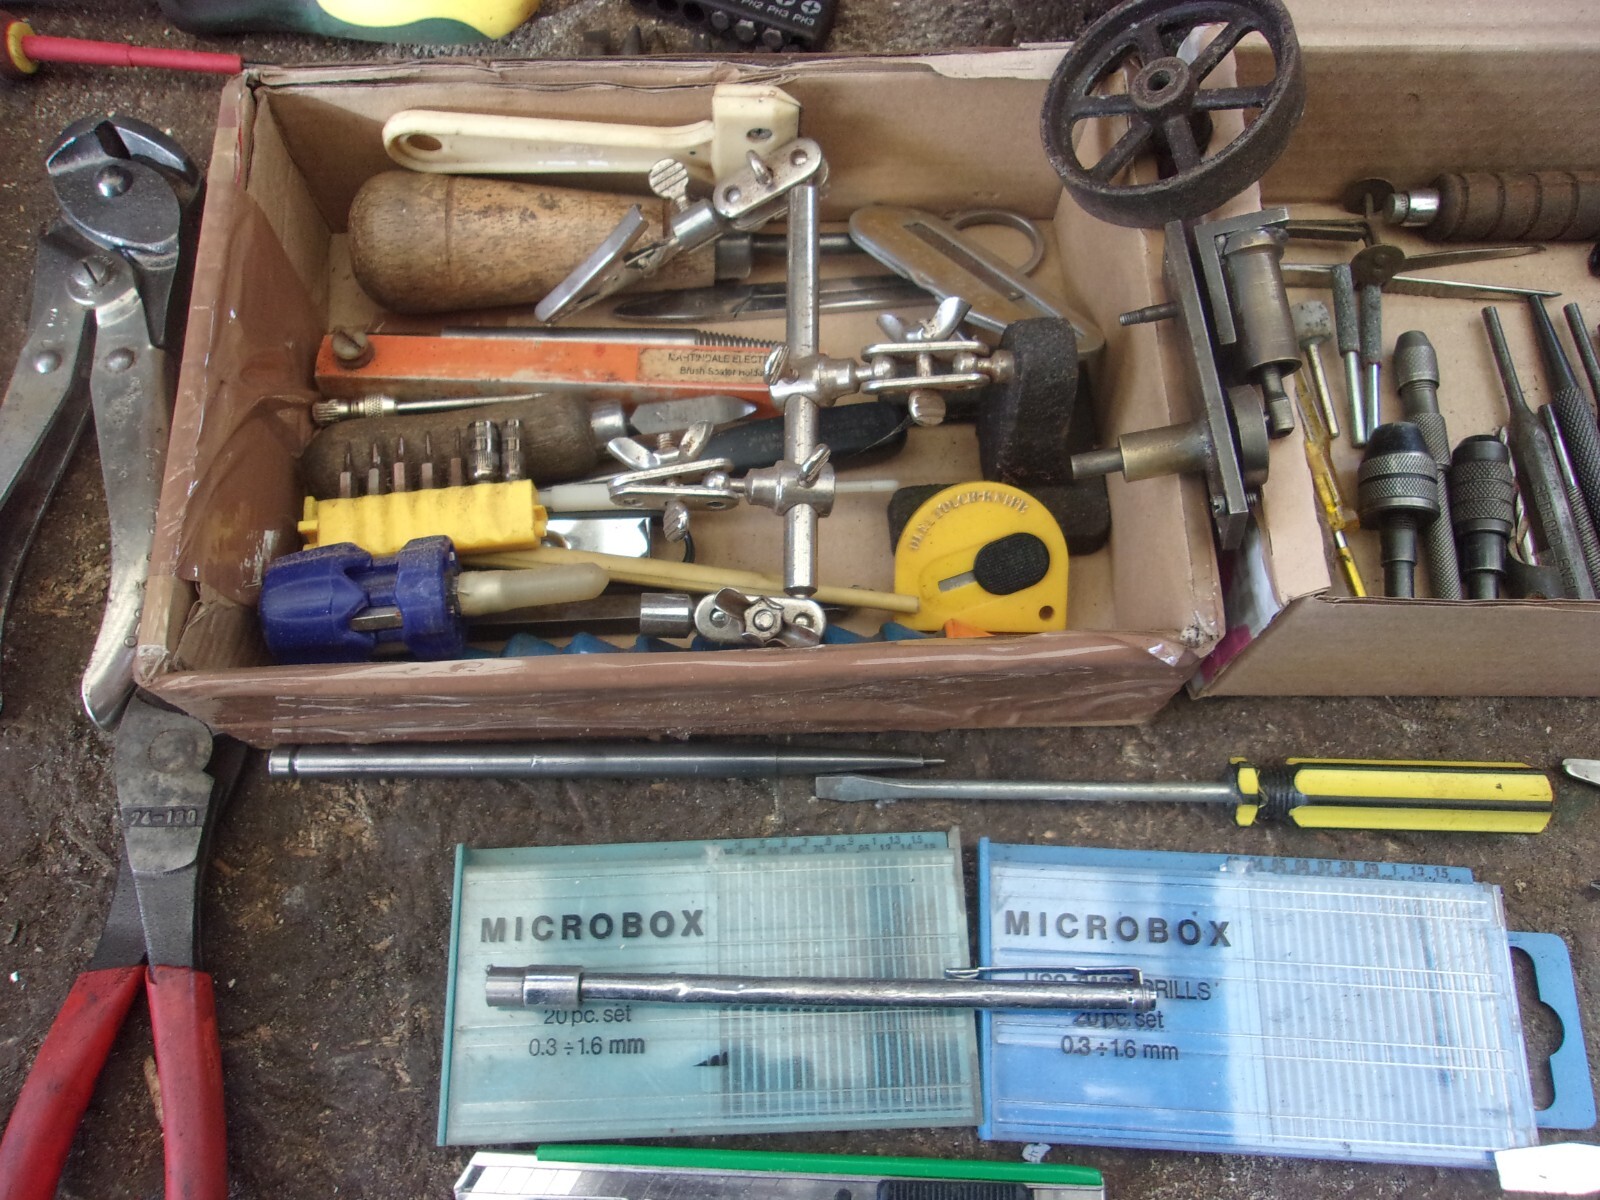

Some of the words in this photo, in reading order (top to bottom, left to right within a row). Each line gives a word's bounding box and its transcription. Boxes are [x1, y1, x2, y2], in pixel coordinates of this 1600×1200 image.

[766, 5, 789, 18] PH3
[792, 13, 815, 26] PH3
[732, 354, 767, 364] ELECT
[480, 909, 704, 942] MICROBOX
[1005, 910, 1232, 948] MICROBOX
[571, 1008, 599, 1027] pc.
[603, 1003, 632, 1023] set
[1134, 1009, 1165, 1029] set
[608, 1036, 646, 1055] mm
[1142, 1043, 1179, 1061] mm
